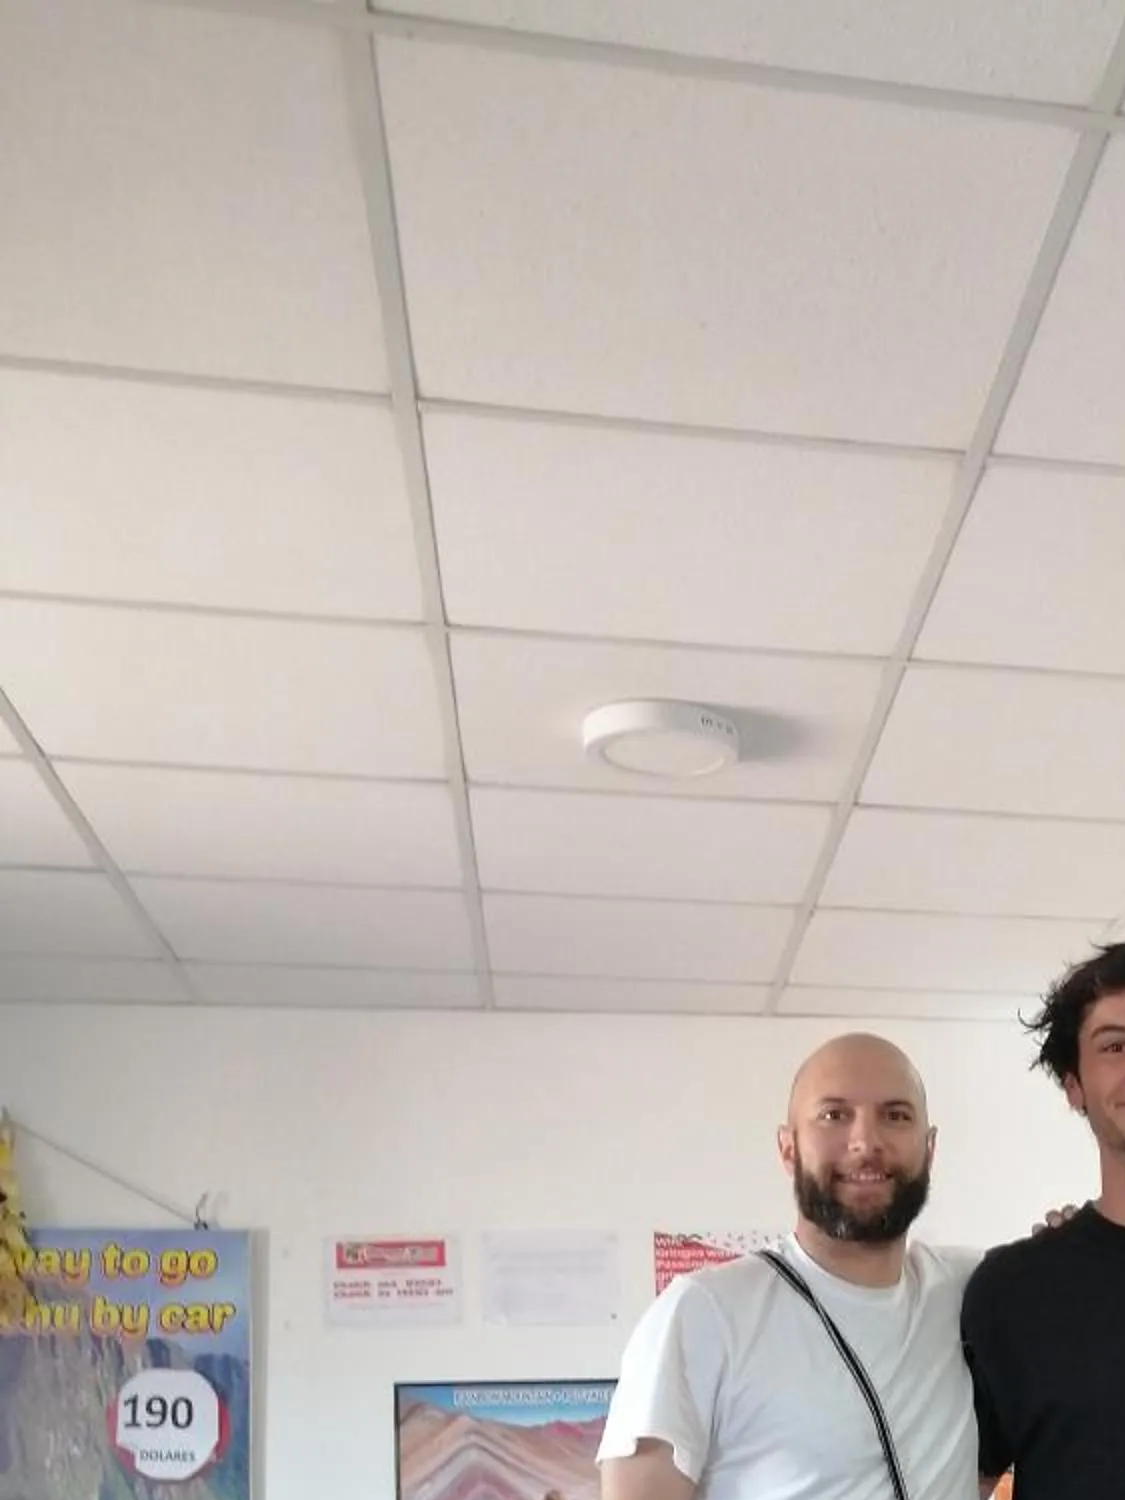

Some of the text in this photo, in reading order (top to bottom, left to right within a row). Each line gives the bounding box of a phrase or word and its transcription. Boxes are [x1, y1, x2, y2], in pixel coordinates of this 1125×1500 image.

[102, 1241, 150, 1278] to
[160, 1249, 218, 1287] go
[91, 1296, 149, 1336] by
[160, 1302, 235, 1333] car
[123, 1394, 194, 1429] 190
[140, 1448, 196, 1462] DOLARES
